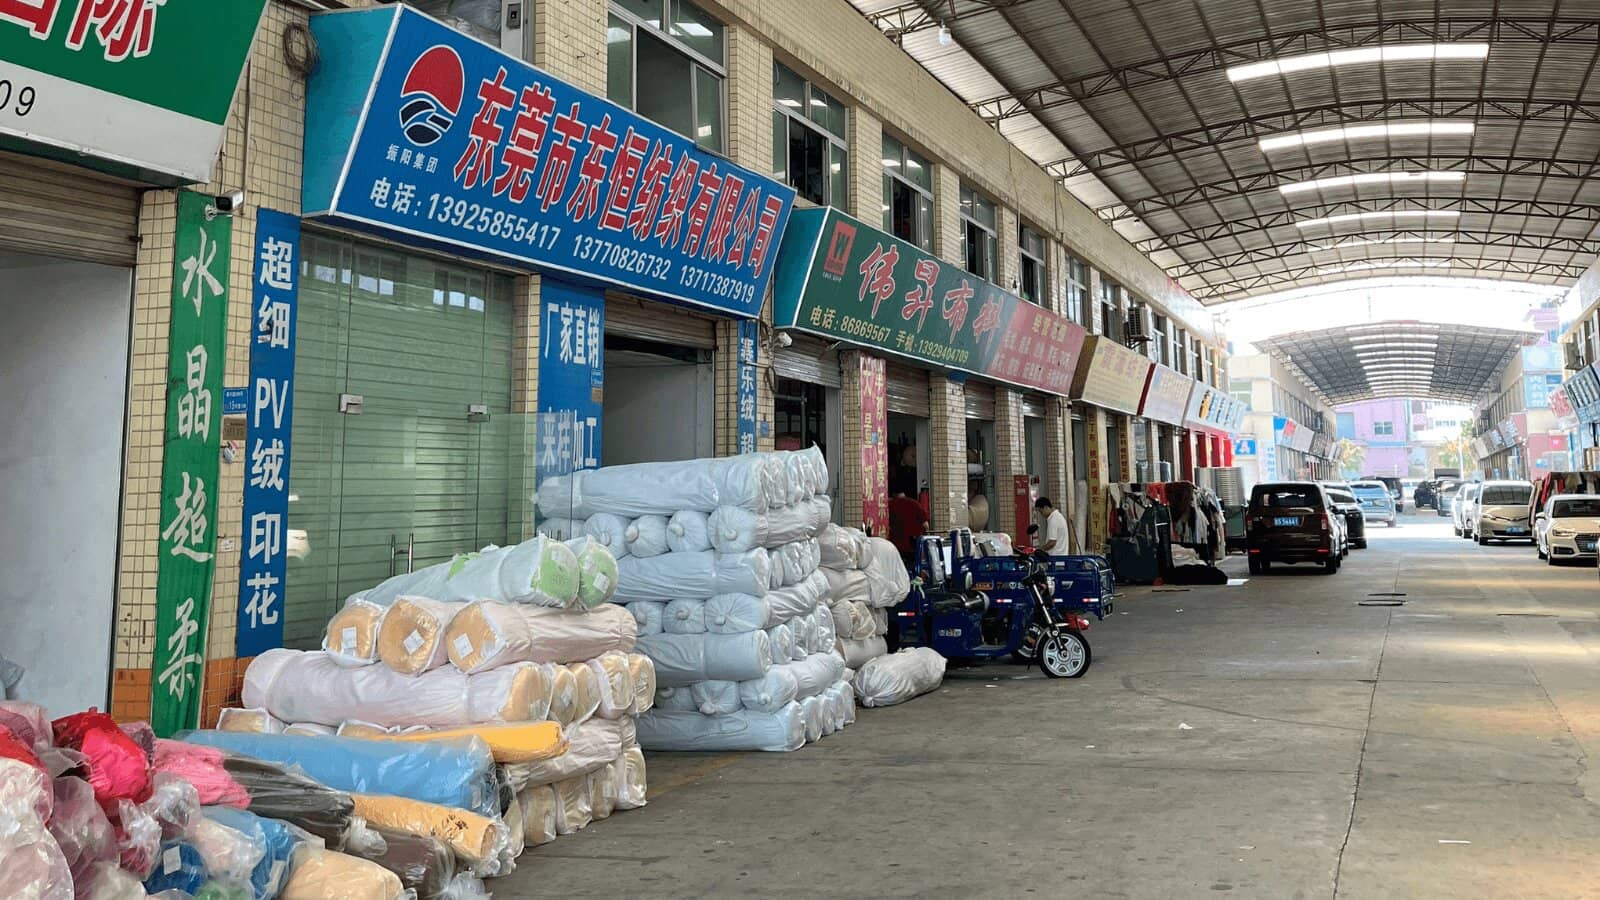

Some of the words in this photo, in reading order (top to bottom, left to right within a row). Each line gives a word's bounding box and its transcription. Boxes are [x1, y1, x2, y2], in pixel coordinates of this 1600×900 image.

[385, 143, 439, 174] 振阳集团
[453, 66, 784, 279] 东莞市东恒纺织有限公司
[572, 234, 672, 281] 13770826732
[679, 264, 755, 304] 13717387919
[544, 301, 599, 369] 厂家直销
[542, 406, 597, 473] 来样加工
